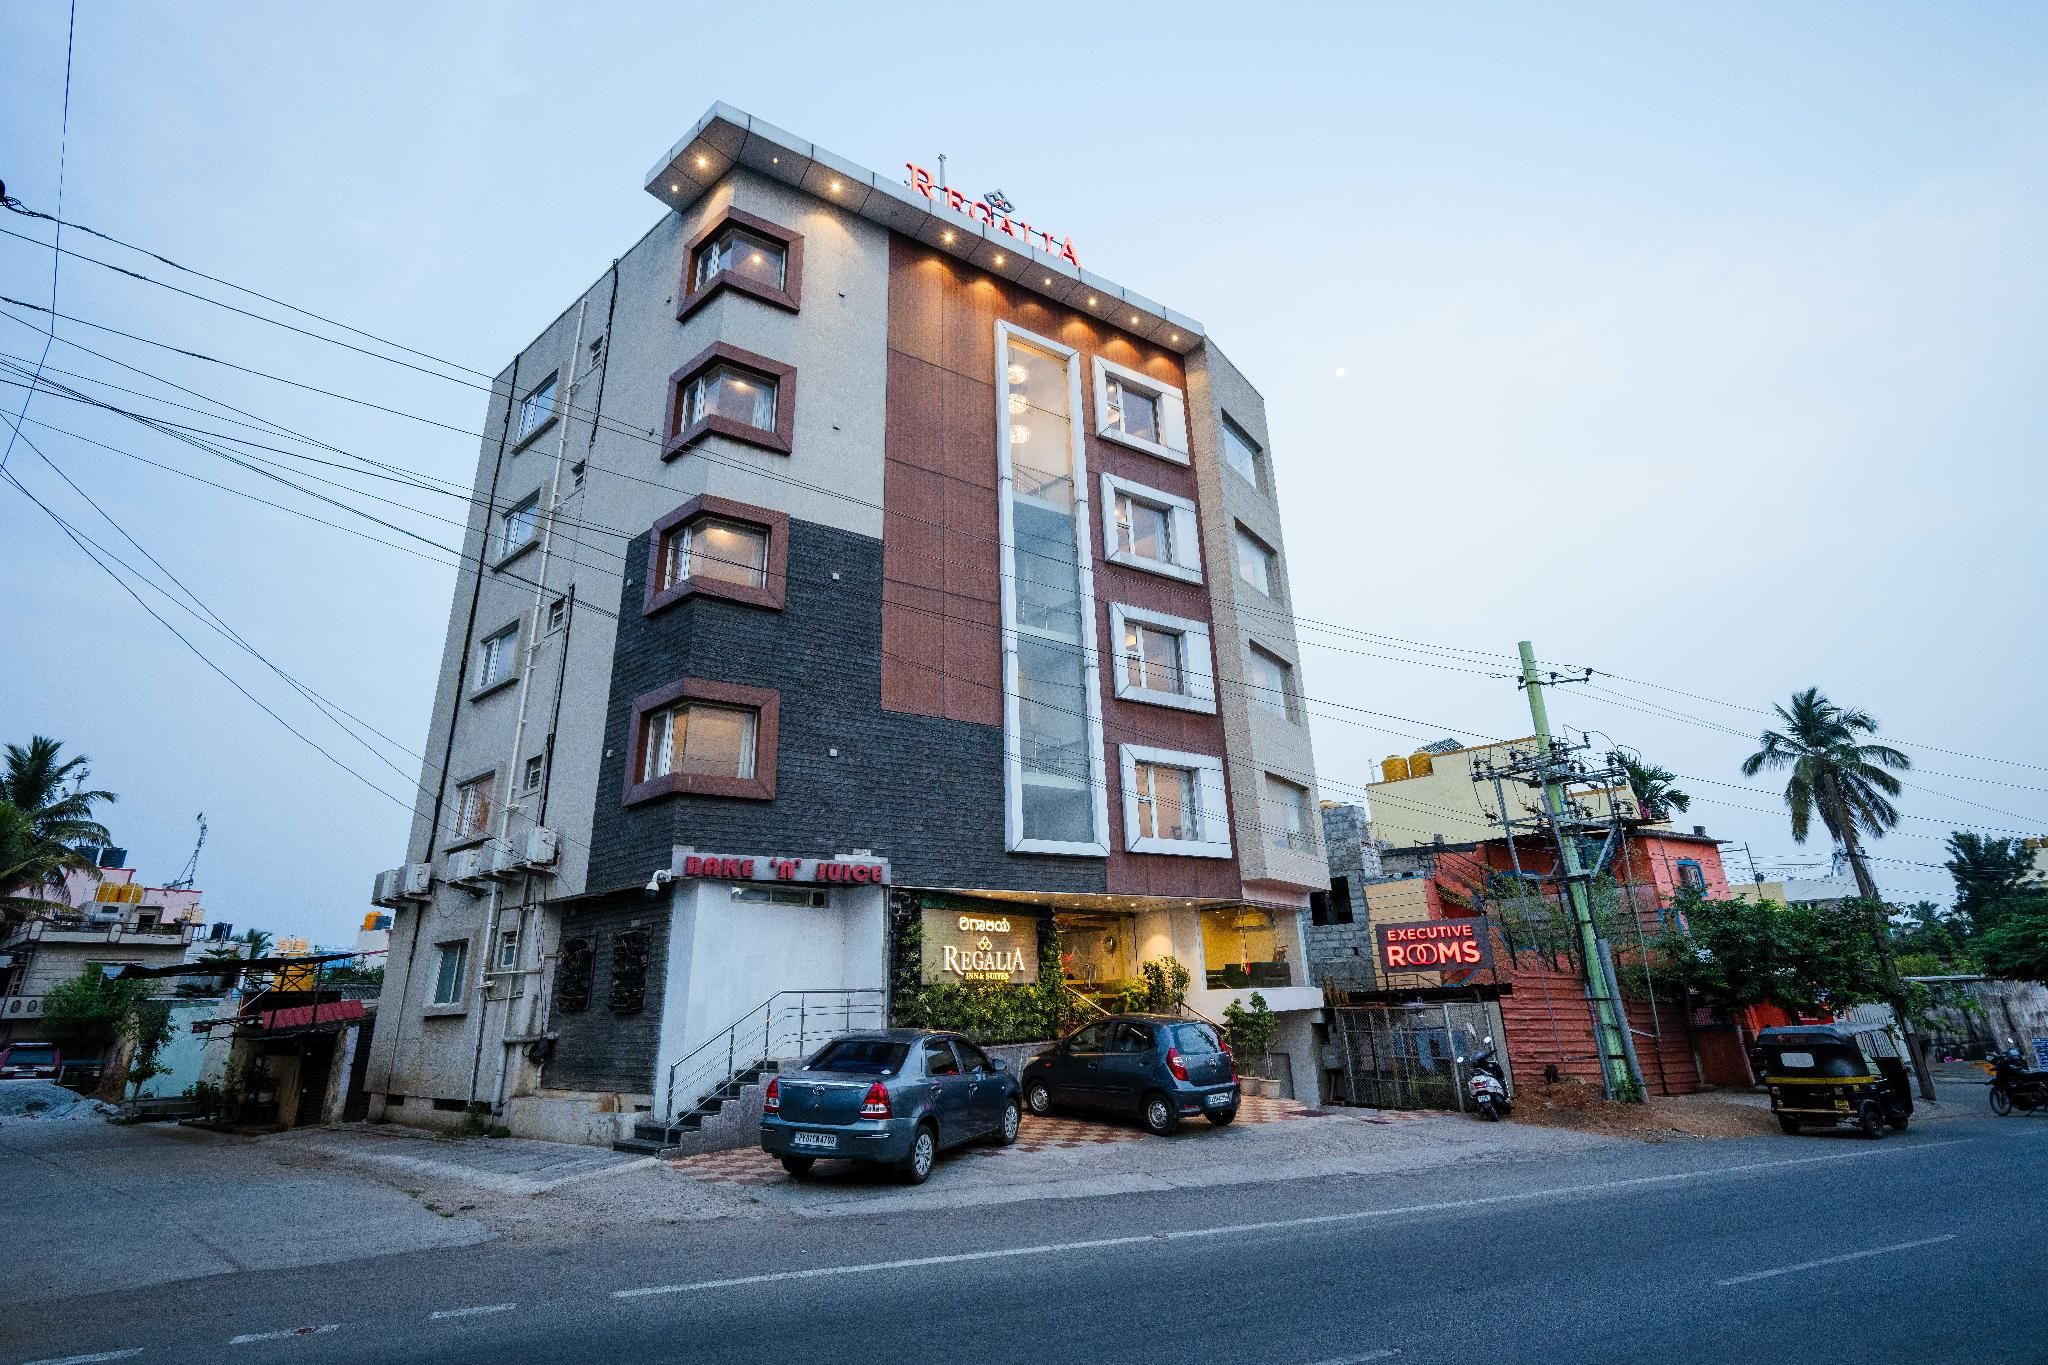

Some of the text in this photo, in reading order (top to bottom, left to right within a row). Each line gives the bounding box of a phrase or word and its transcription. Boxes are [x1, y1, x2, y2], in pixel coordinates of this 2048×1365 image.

[816, 863, 882, 883] JUICE
[1387, 924, 1473, 941] EXECUTIVE
[942, 945, 1025, 976] REGALIA
[1386, 940, 1481, 967] ROOMS
